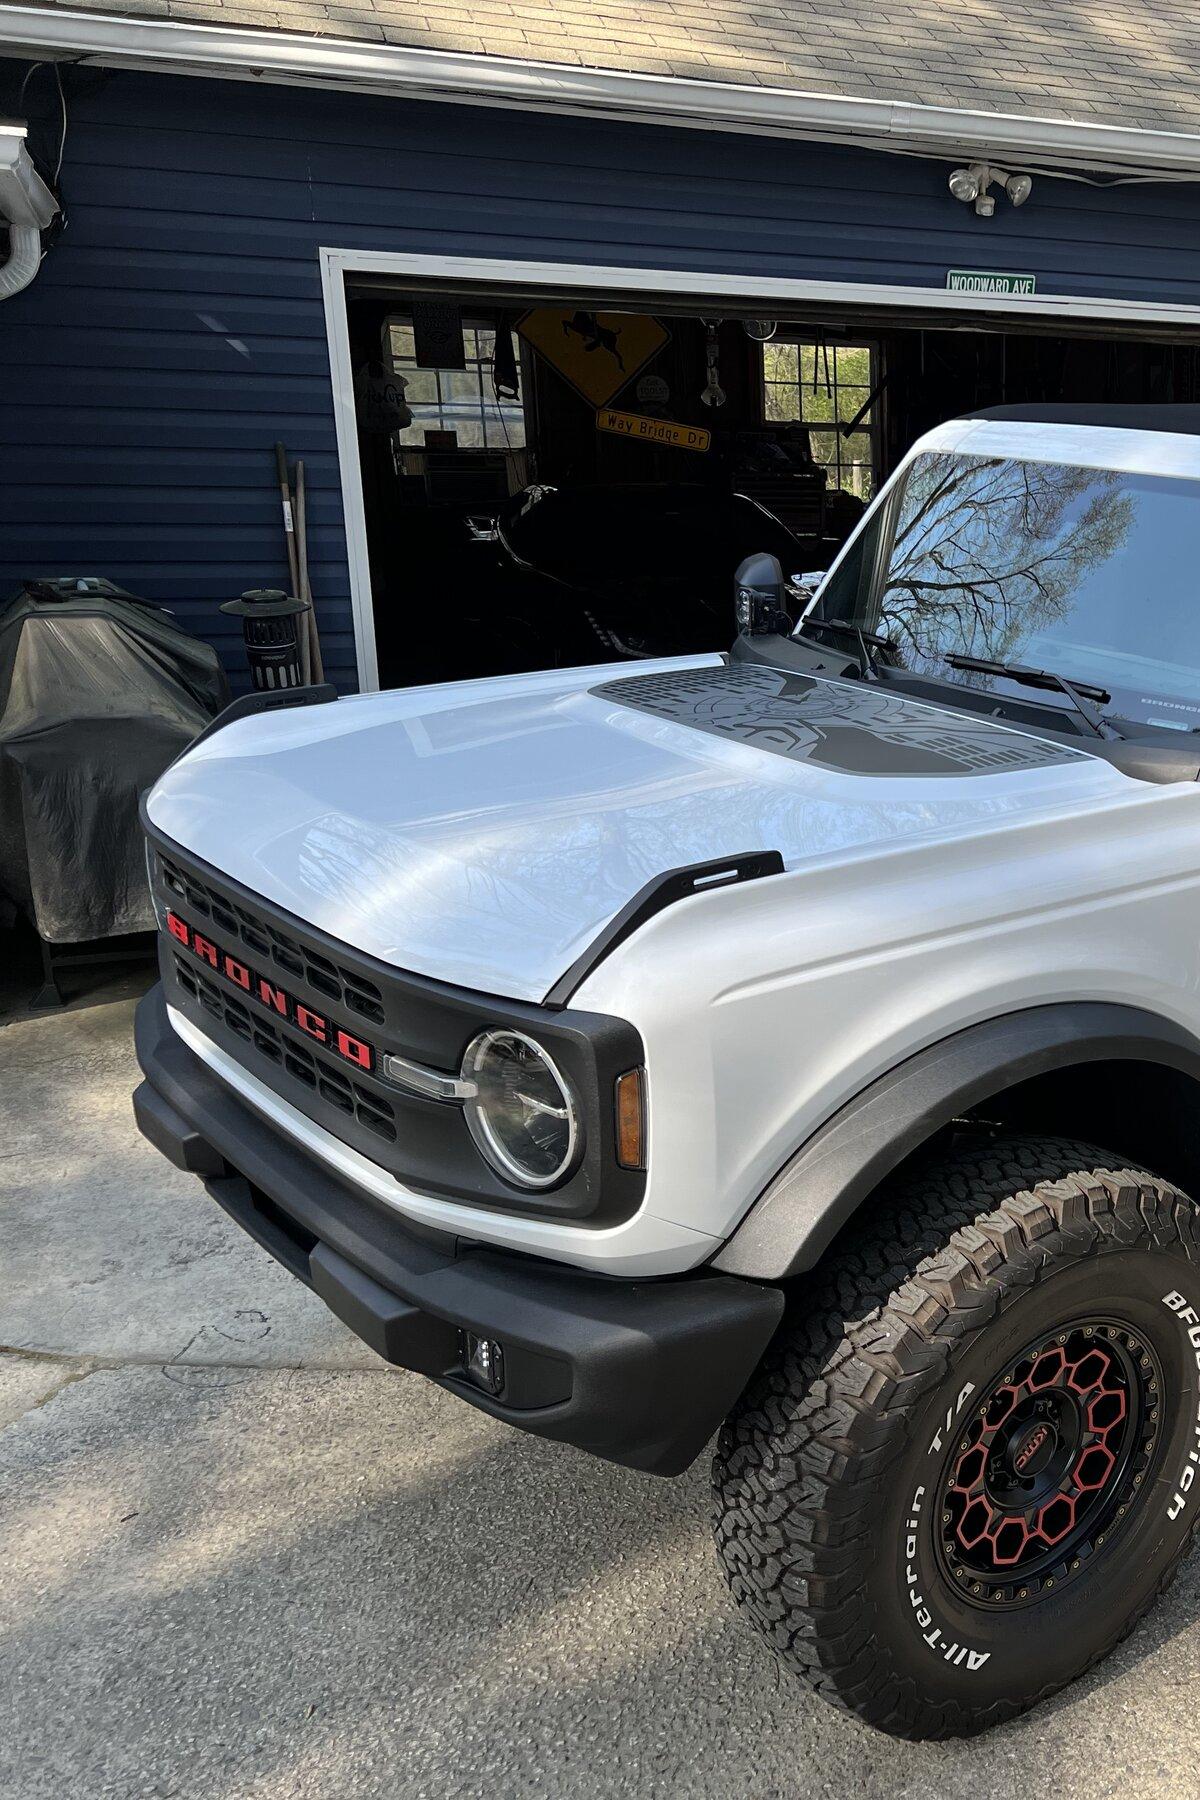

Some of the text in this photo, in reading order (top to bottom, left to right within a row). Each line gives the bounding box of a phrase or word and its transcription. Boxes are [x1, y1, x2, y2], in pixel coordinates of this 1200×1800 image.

[951, 276, 1033, 295] WOODWARD AVE
[607, 414, 704, 445] Way Bridge Dr
[166, 911, 371, 1070] BRONCO
[905, 1485, 992, 1671] All-Terrain
